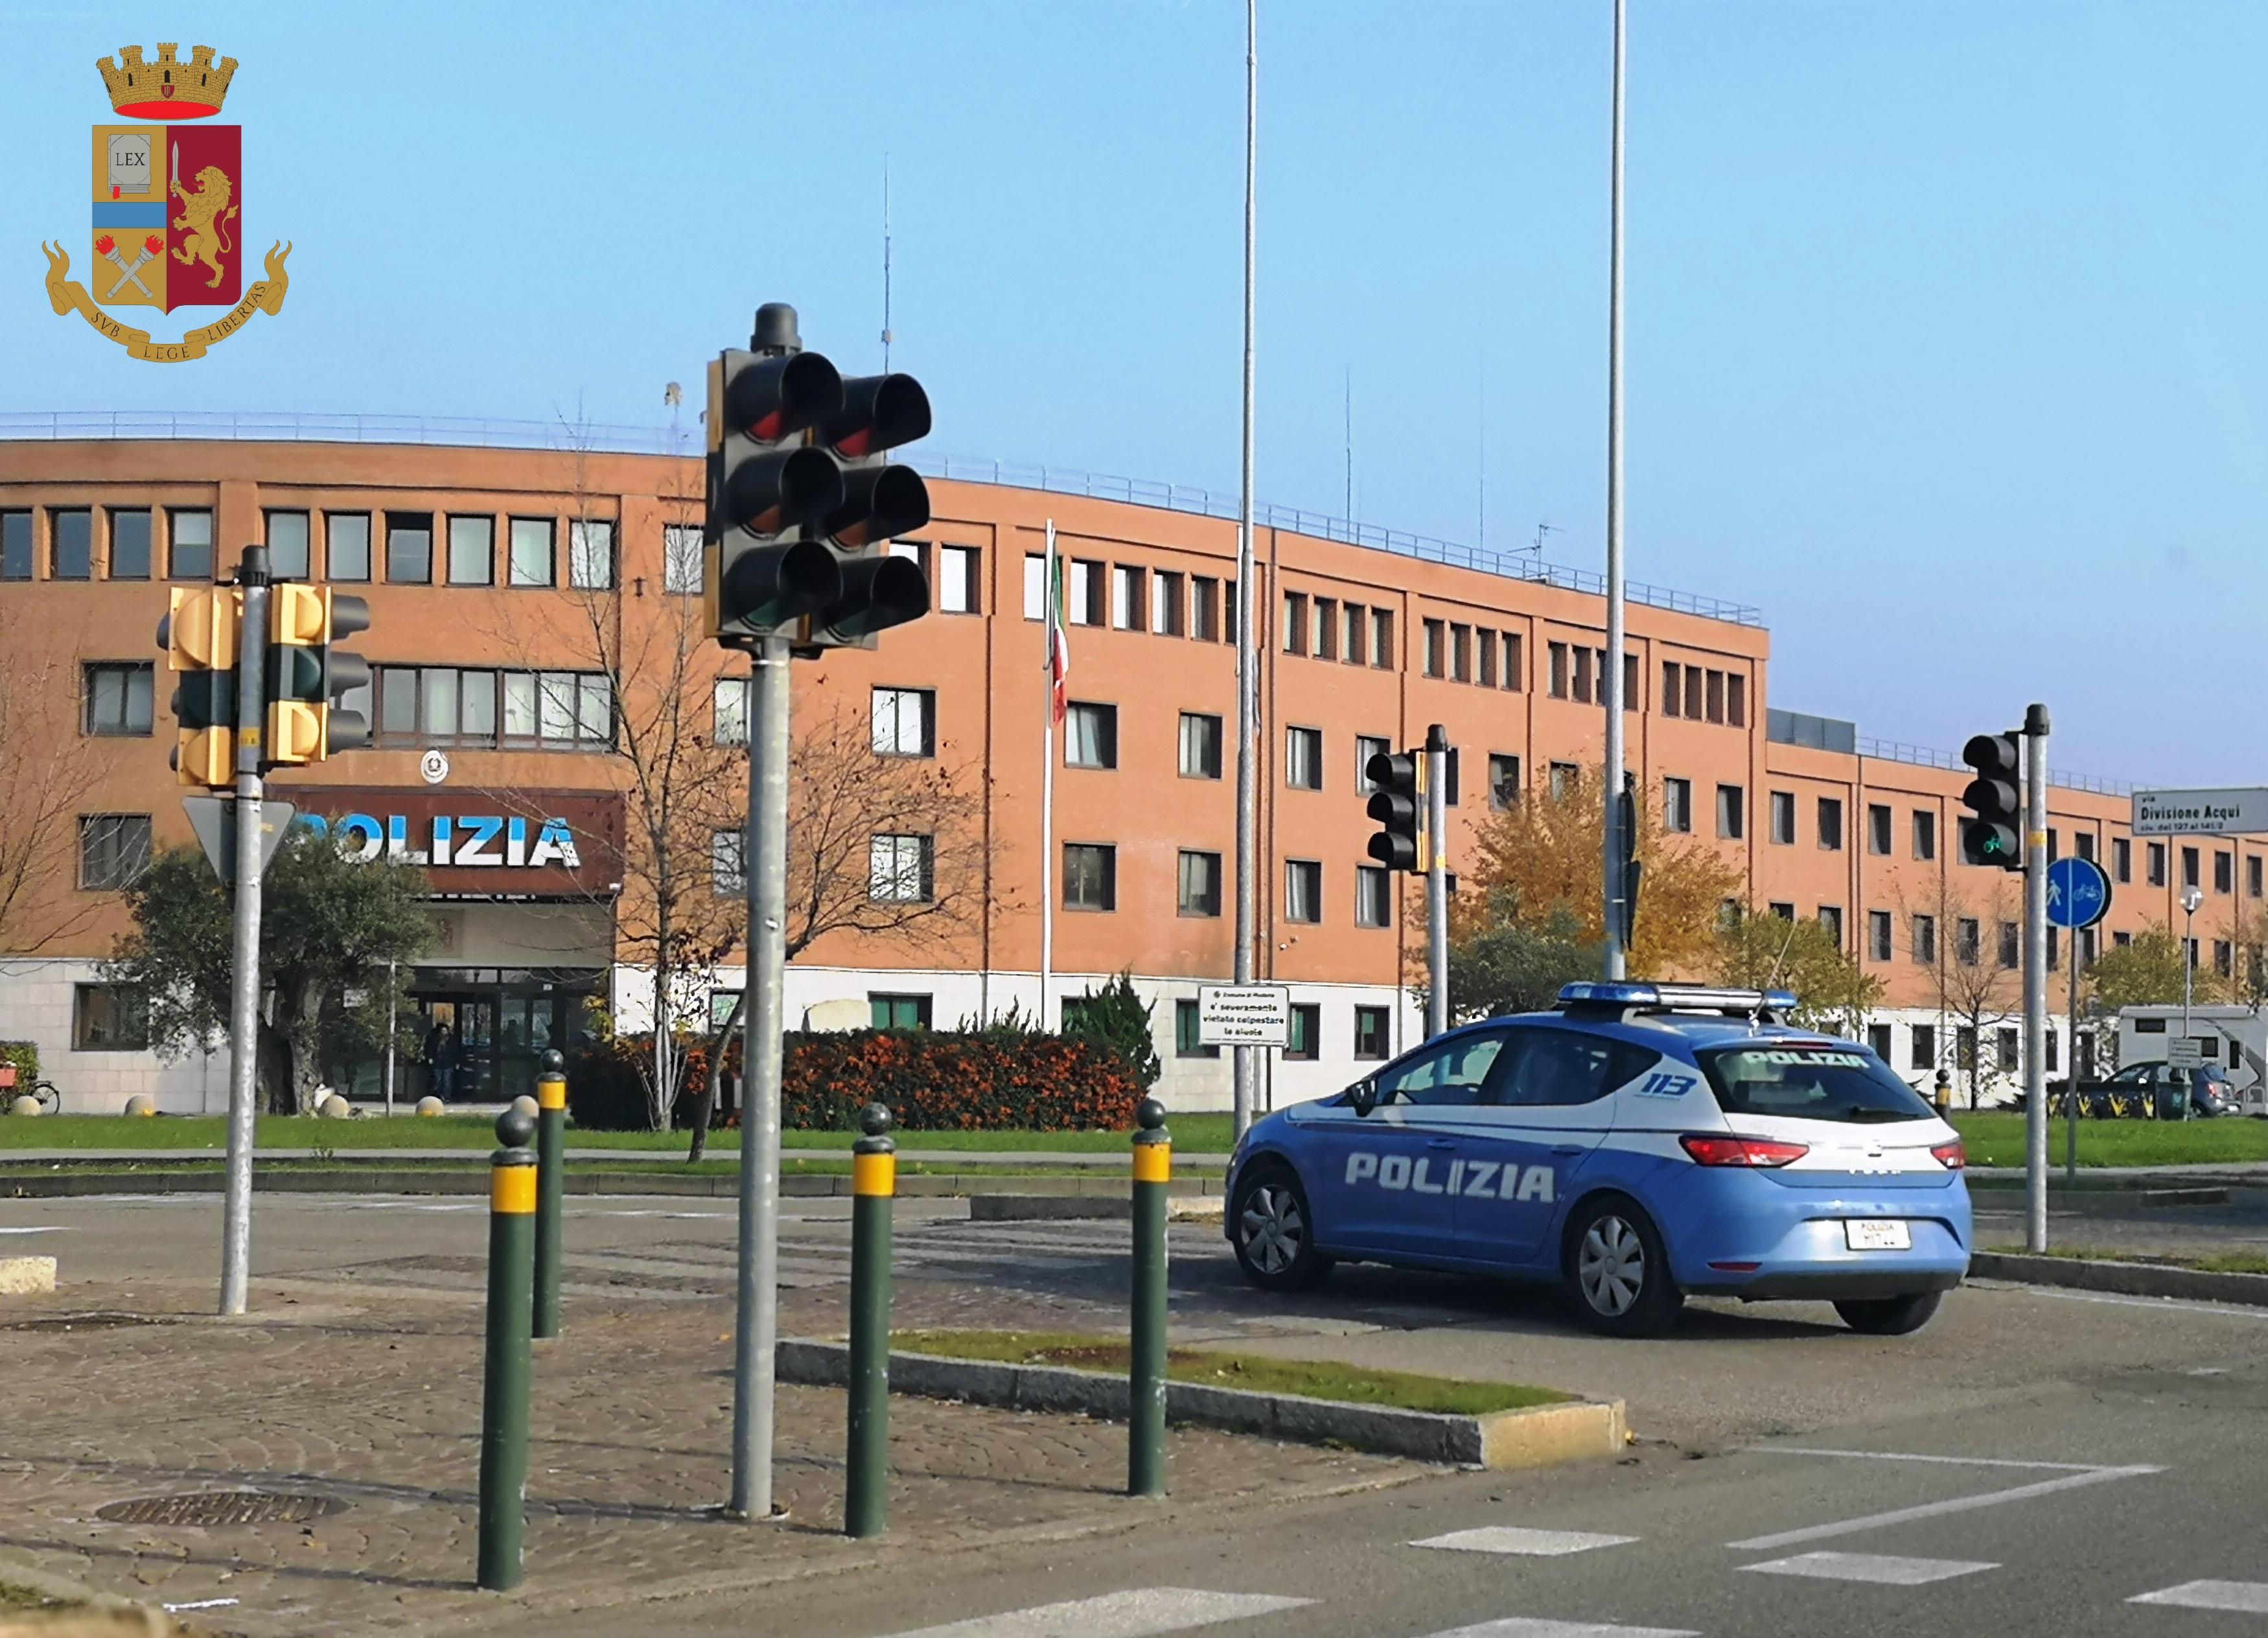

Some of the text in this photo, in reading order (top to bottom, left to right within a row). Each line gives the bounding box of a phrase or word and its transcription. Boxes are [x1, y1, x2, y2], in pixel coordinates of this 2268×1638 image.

[2141, 804, 2240, 820] Divisione Acqui
[1742, 1051, 1870, 1068] POLIZIA
[1641, 1073, 1697, 1096] 113
[1345, 1152, 1555, 1203] POLIZIA
